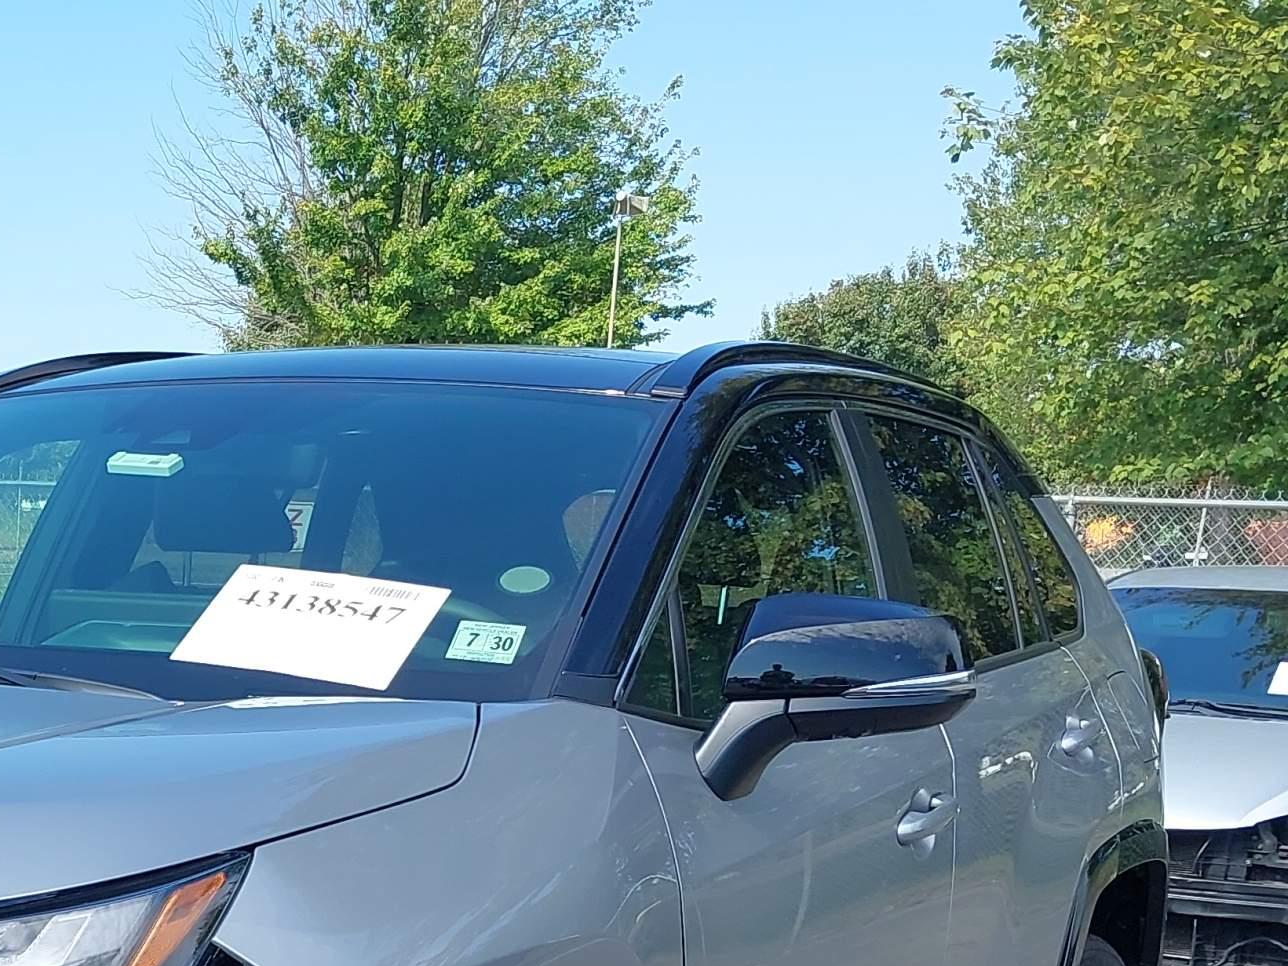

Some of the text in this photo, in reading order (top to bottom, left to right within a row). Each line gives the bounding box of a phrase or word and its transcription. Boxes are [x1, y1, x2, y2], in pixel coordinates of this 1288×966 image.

[238, 588, 408, 625] 43138547
[466, 632, 514, 652] 7 30
